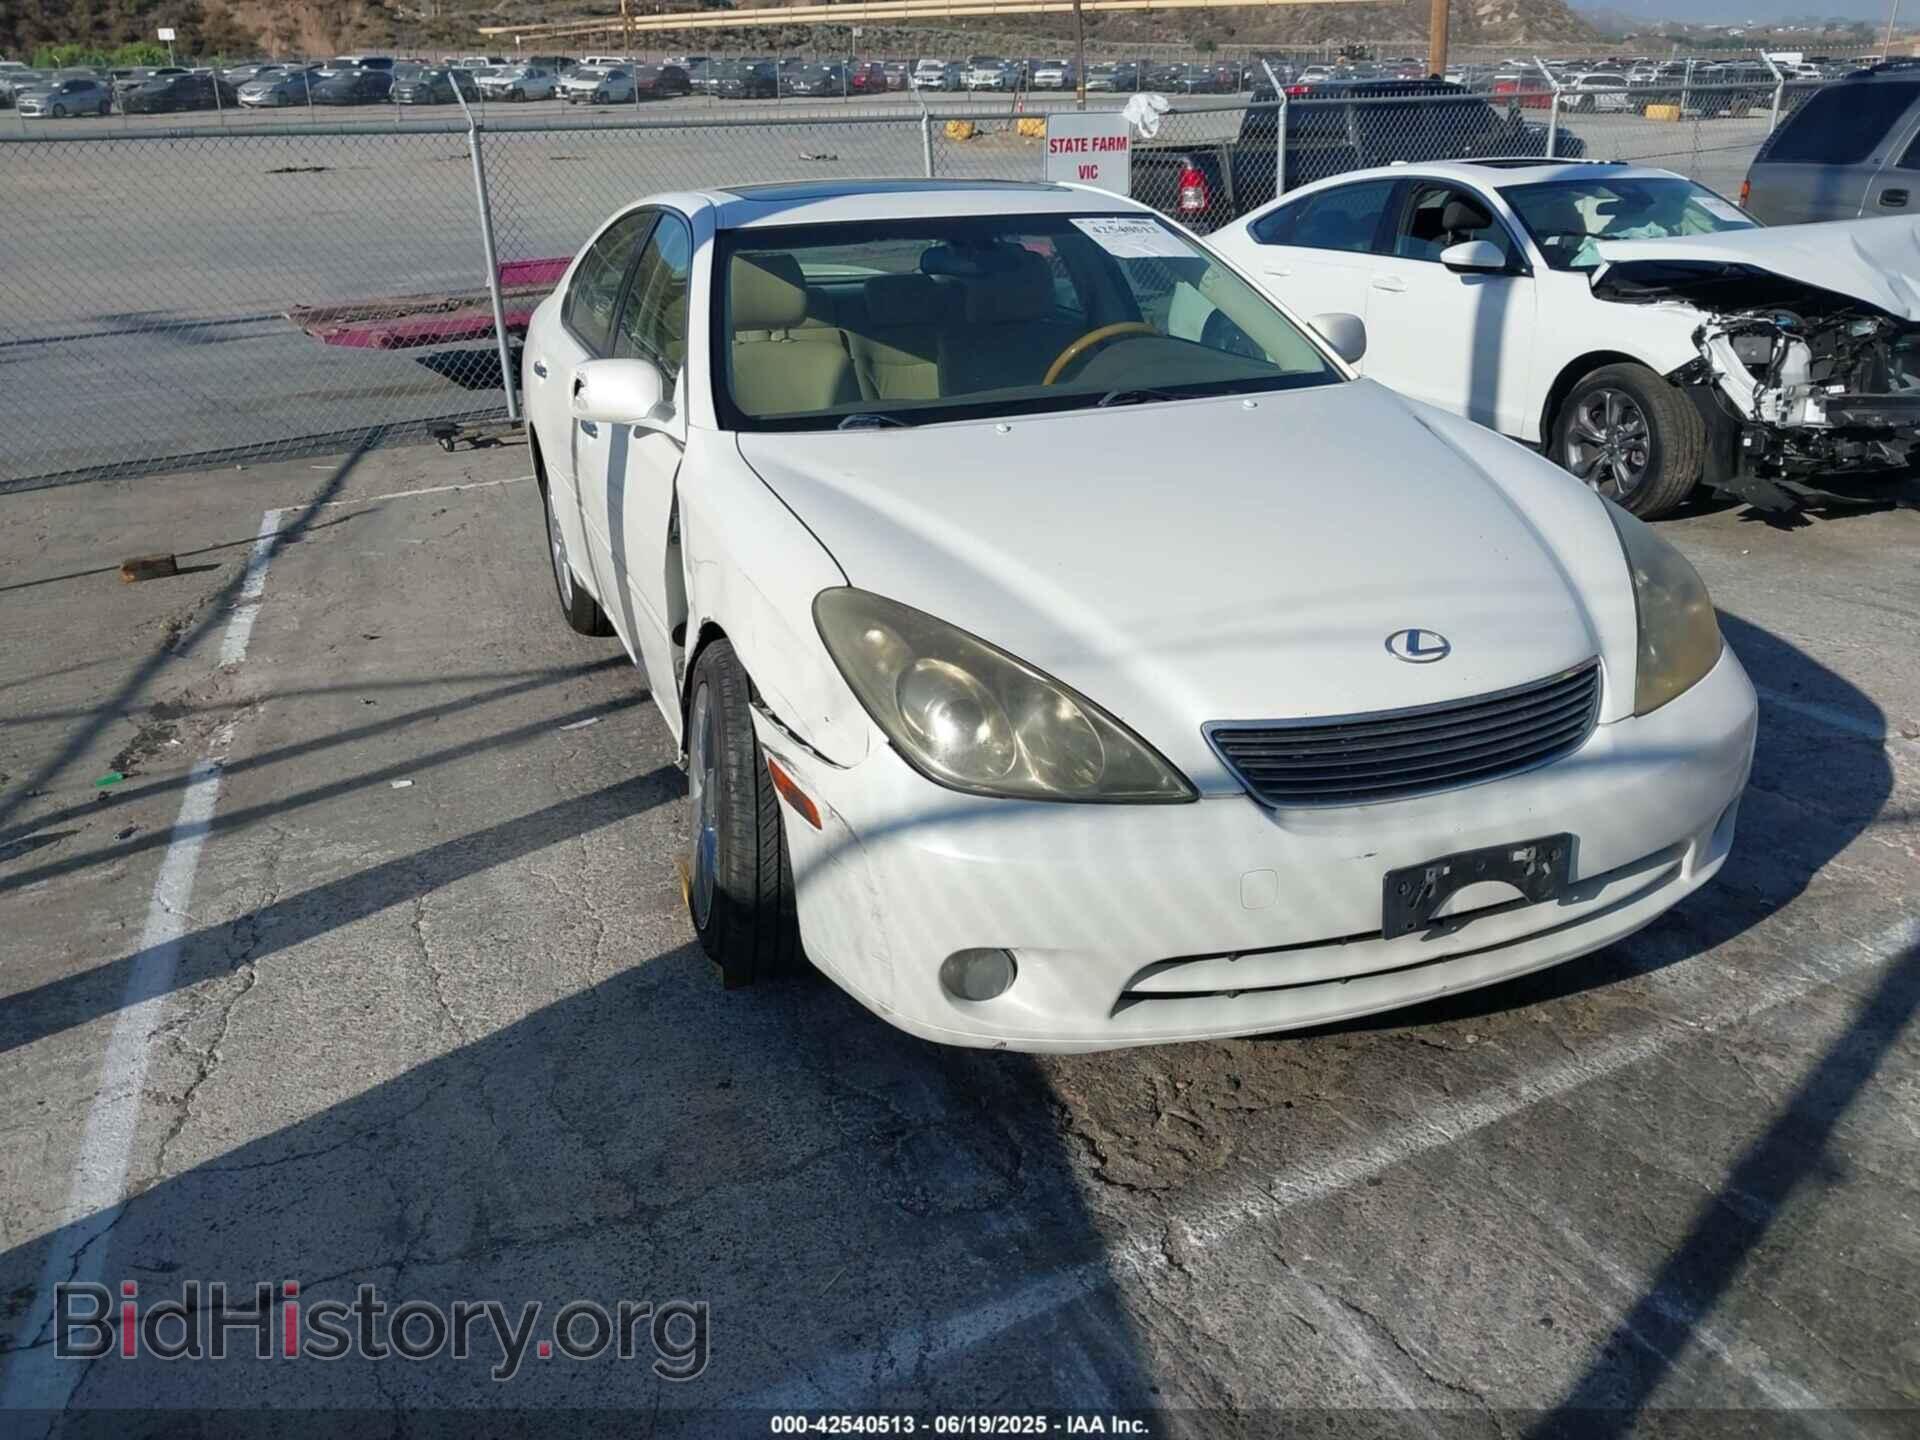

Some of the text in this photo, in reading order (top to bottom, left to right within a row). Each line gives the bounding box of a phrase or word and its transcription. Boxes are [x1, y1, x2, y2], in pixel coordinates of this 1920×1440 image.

[1049, 136, 1128, 154] STATE FARM
[1078, 164, 1099, 180] VIC
